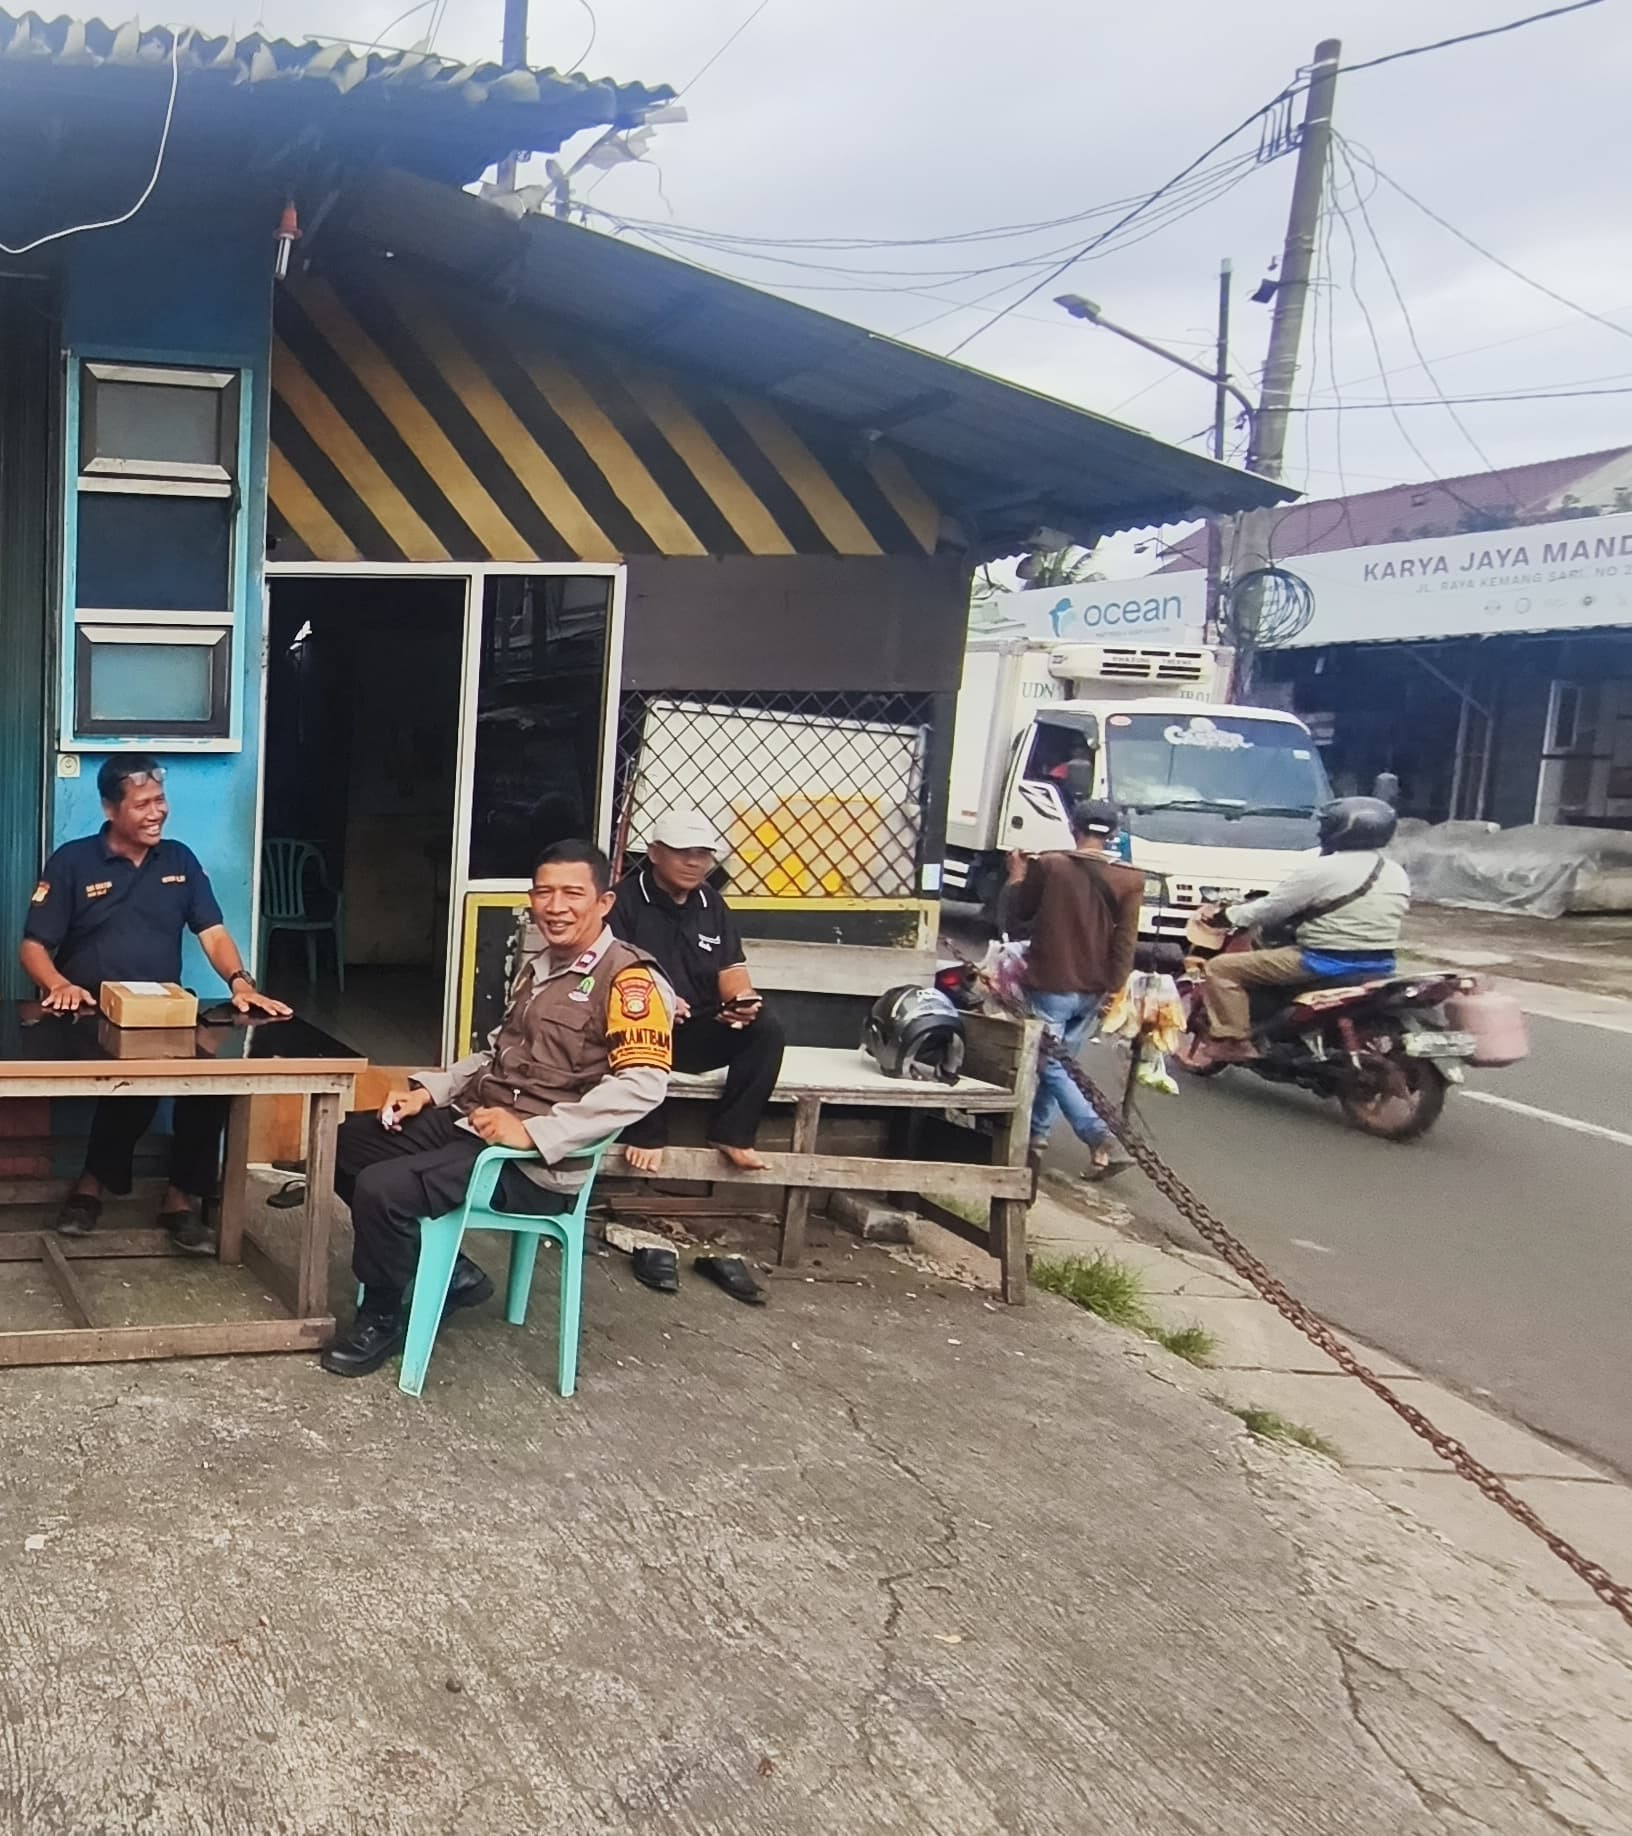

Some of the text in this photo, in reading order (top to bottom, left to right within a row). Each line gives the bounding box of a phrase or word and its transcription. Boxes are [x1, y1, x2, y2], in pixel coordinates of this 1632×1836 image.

[1363, 556, 1449, 582] KARYA
[1459, 546, 1529, 572] JAYA
[1440, 578, 1475, 592] RAYA
[1083, 595, 1182, 627] ocean
